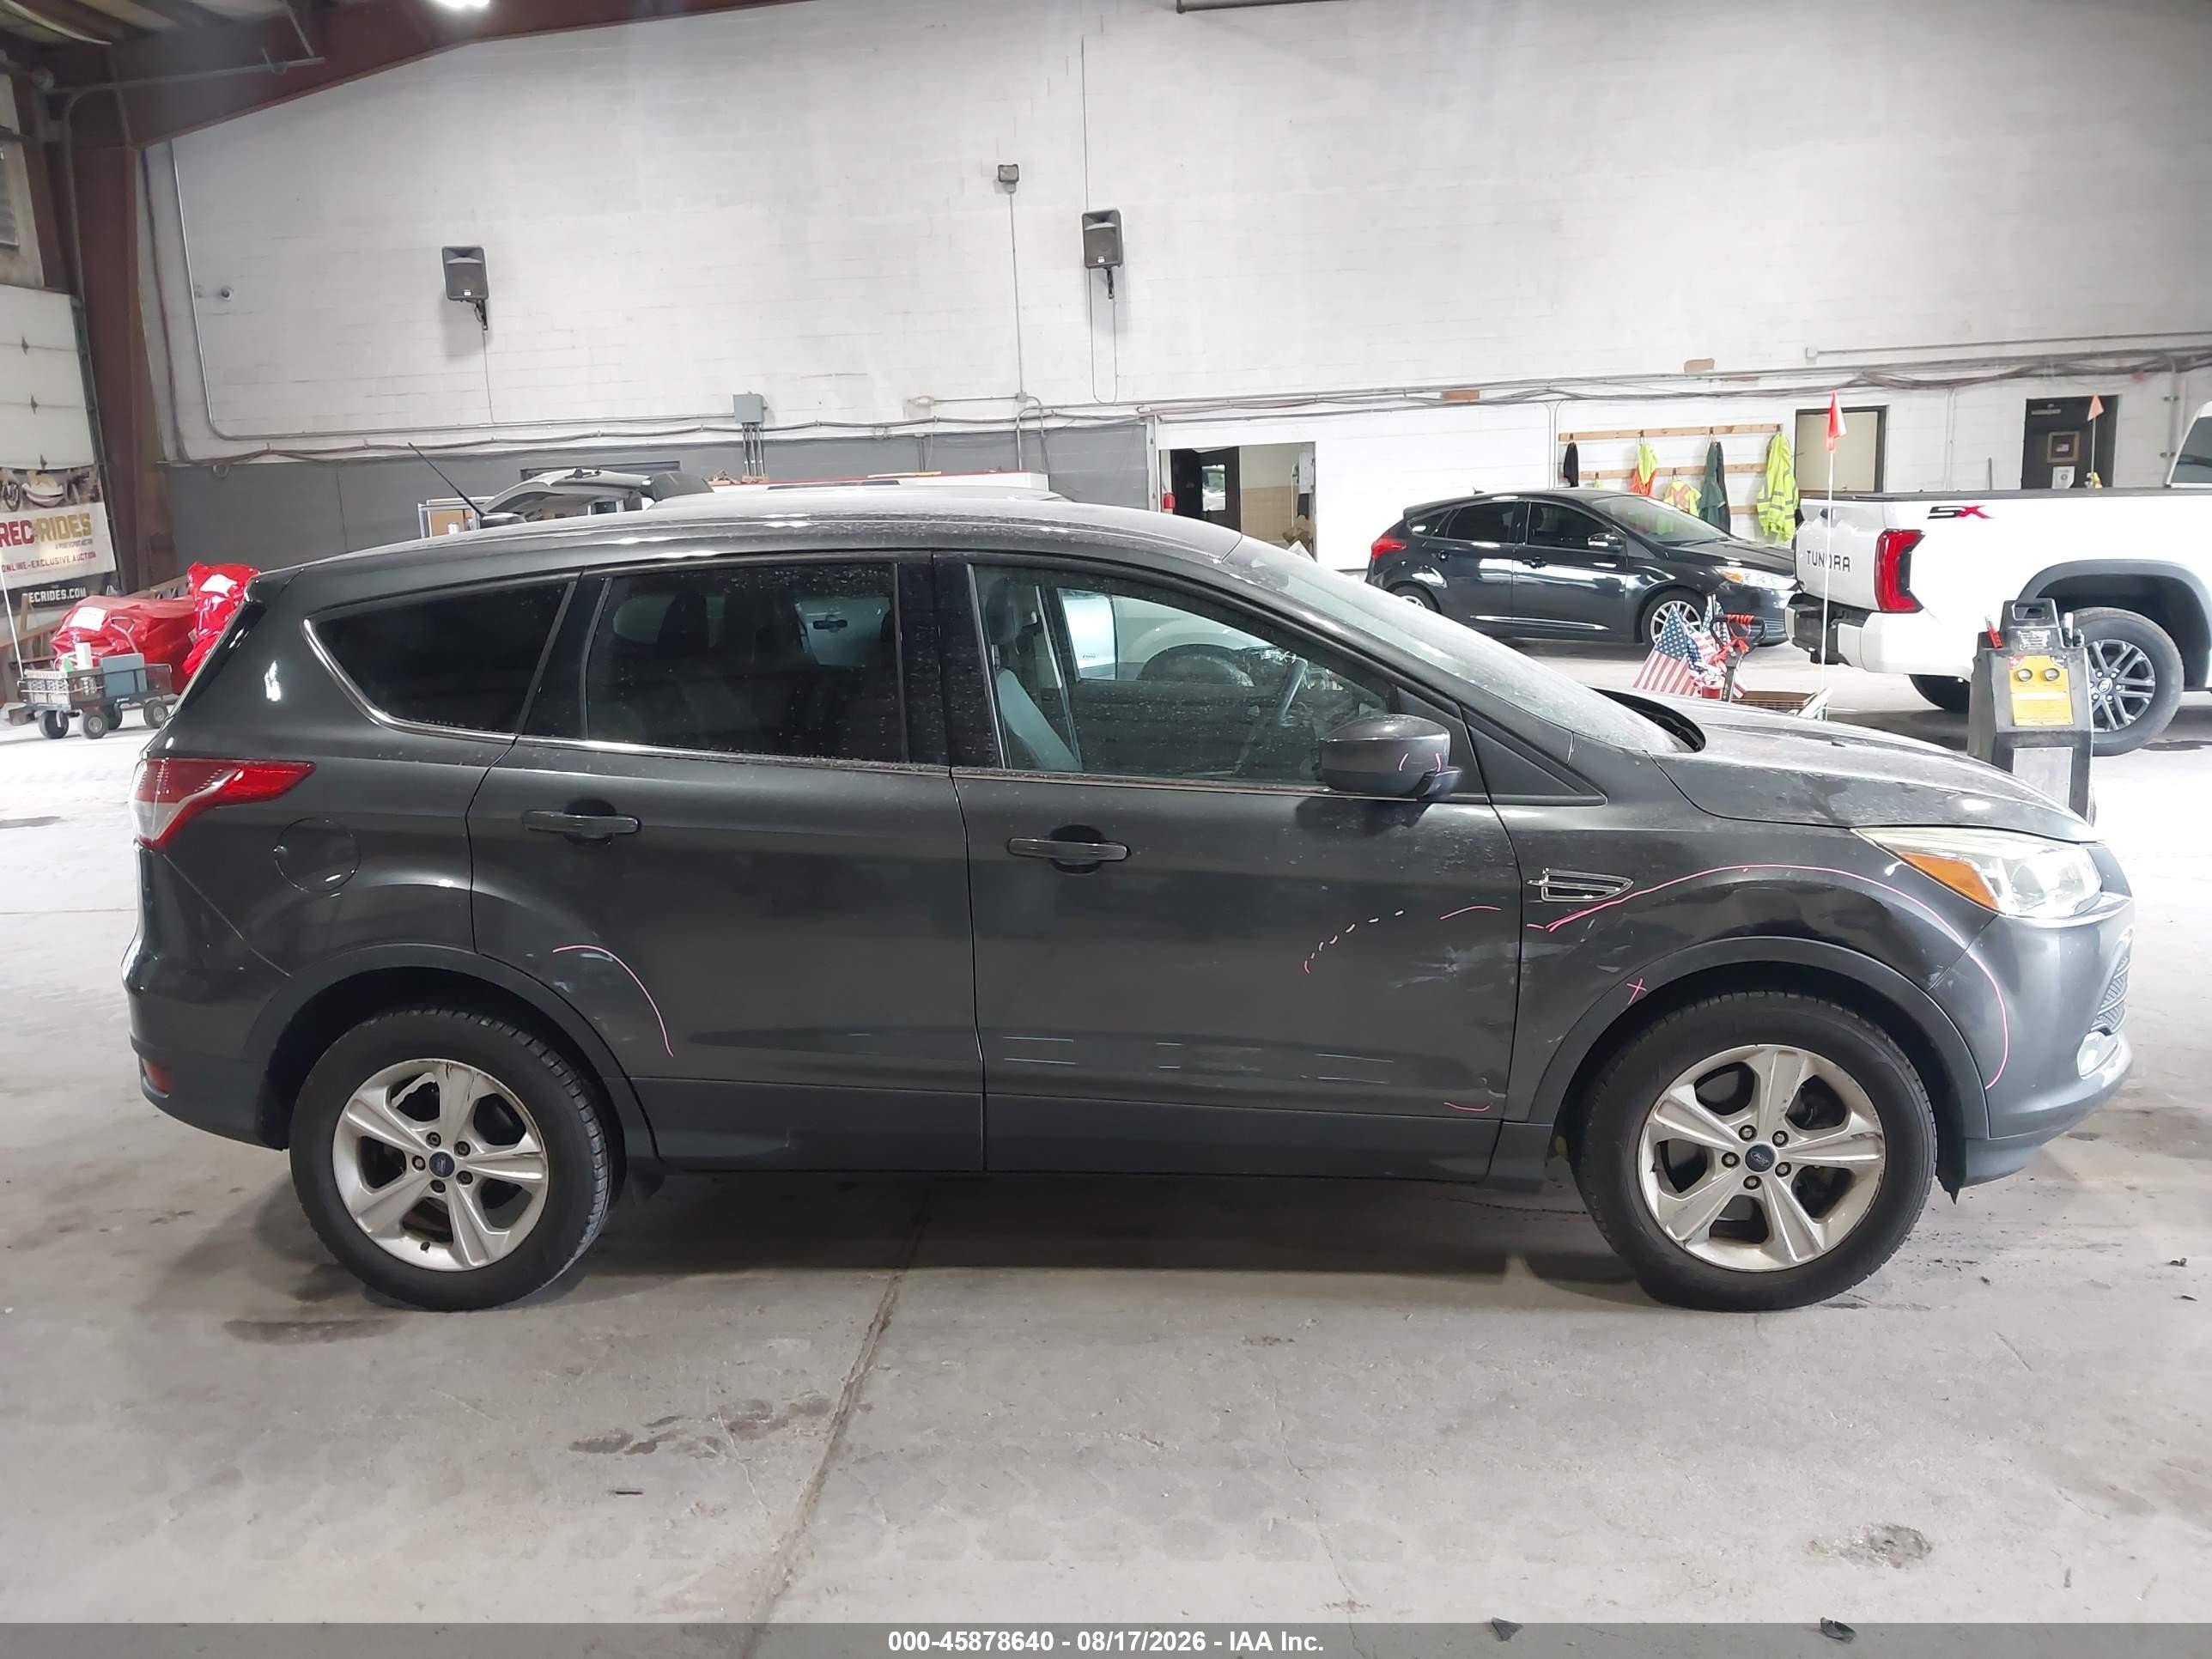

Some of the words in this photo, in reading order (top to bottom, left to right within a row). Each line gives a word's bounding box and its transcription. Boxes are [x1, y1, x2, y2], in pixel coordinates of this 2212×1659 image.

[0, 520, 34, 547] REC
[36, 513, 92, 542] RIDES
[28, 586, 87, 603] ECRIDES.COM
